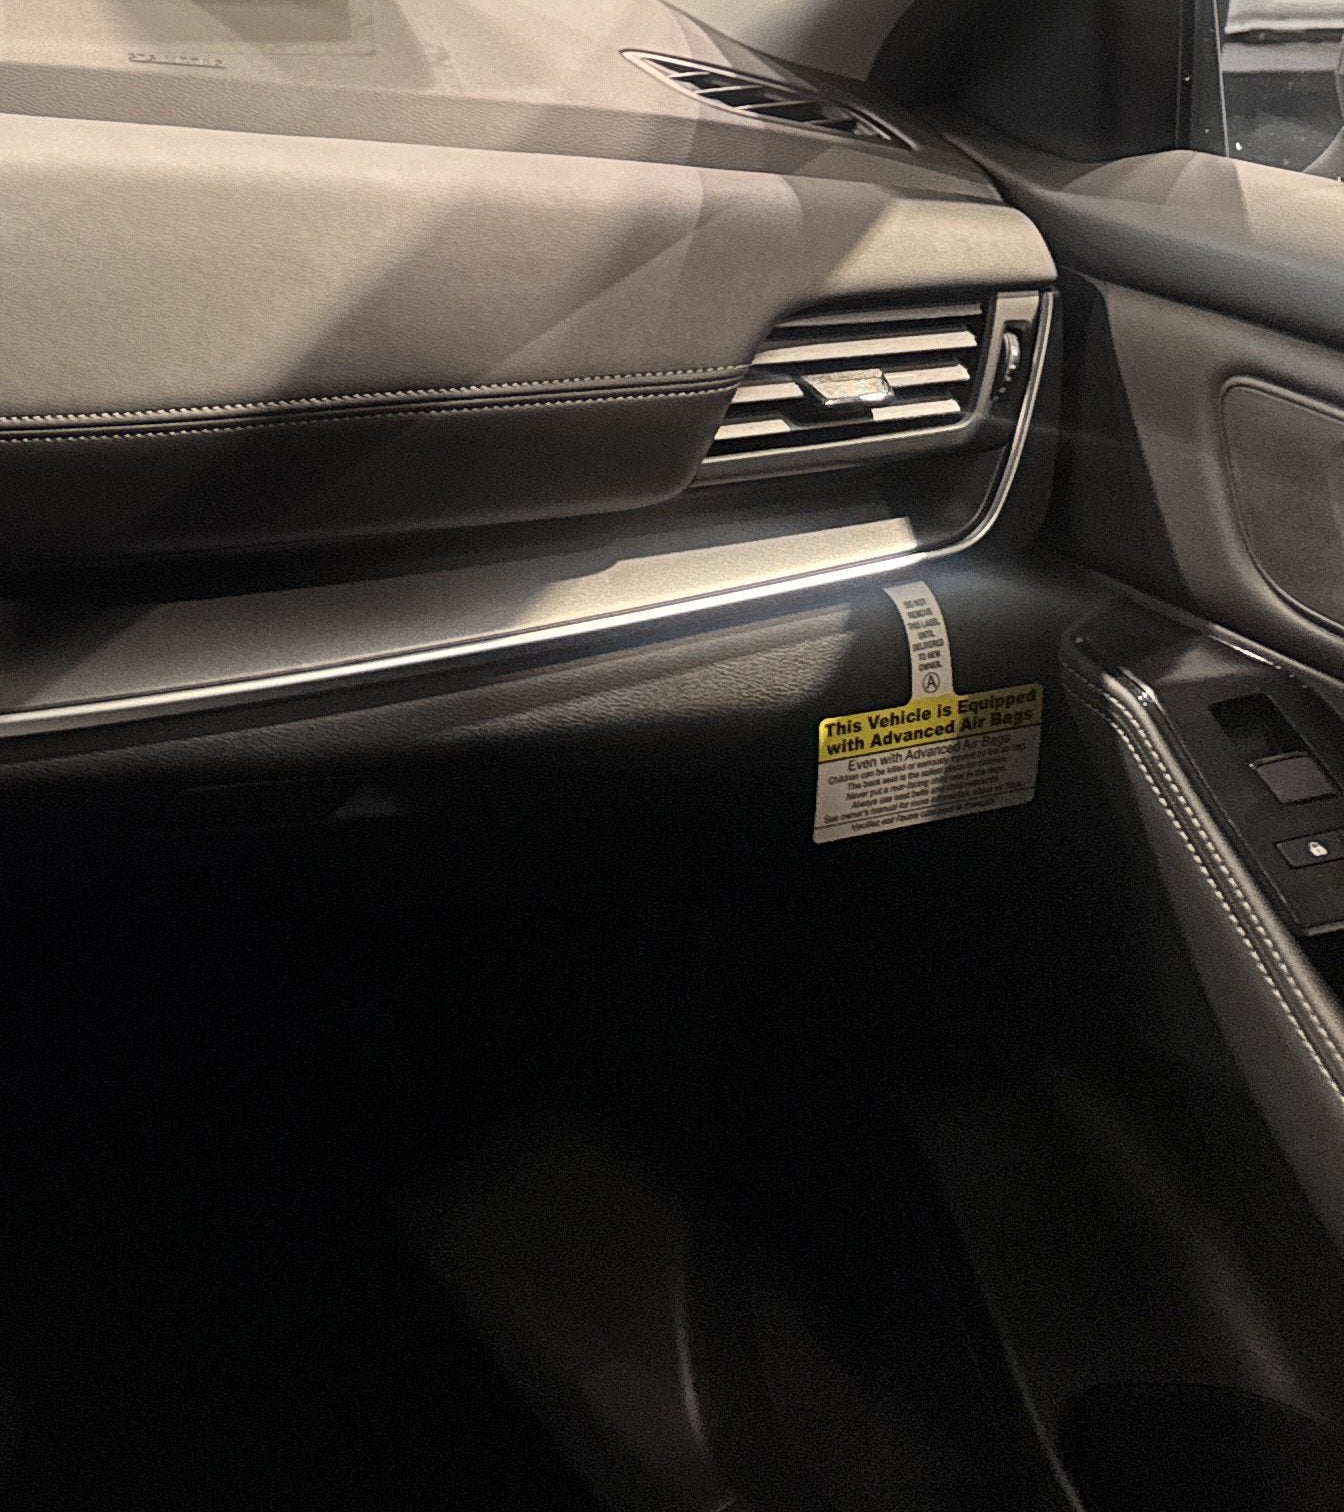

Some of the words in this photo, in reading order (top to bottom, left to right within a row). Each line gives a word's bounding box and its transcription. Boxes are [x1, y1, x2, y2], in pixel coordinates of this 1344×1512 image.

[825, 720, 862, 737] This
[868, 707, 932, 730] Vehicle
[937, 704, 953, 718] is
[957, 688, 1037, 715] Equipped
[827, 738, 864, 756] with
[870, 720, 956, 748] Advanced
[960, 716, 985, 731] Air
[990, 708, 1033, 727] Bags
[848, 758, 877, 772] Even
[880, 752, 903, 766] with
[905, 740, 961, 761] Advanced
